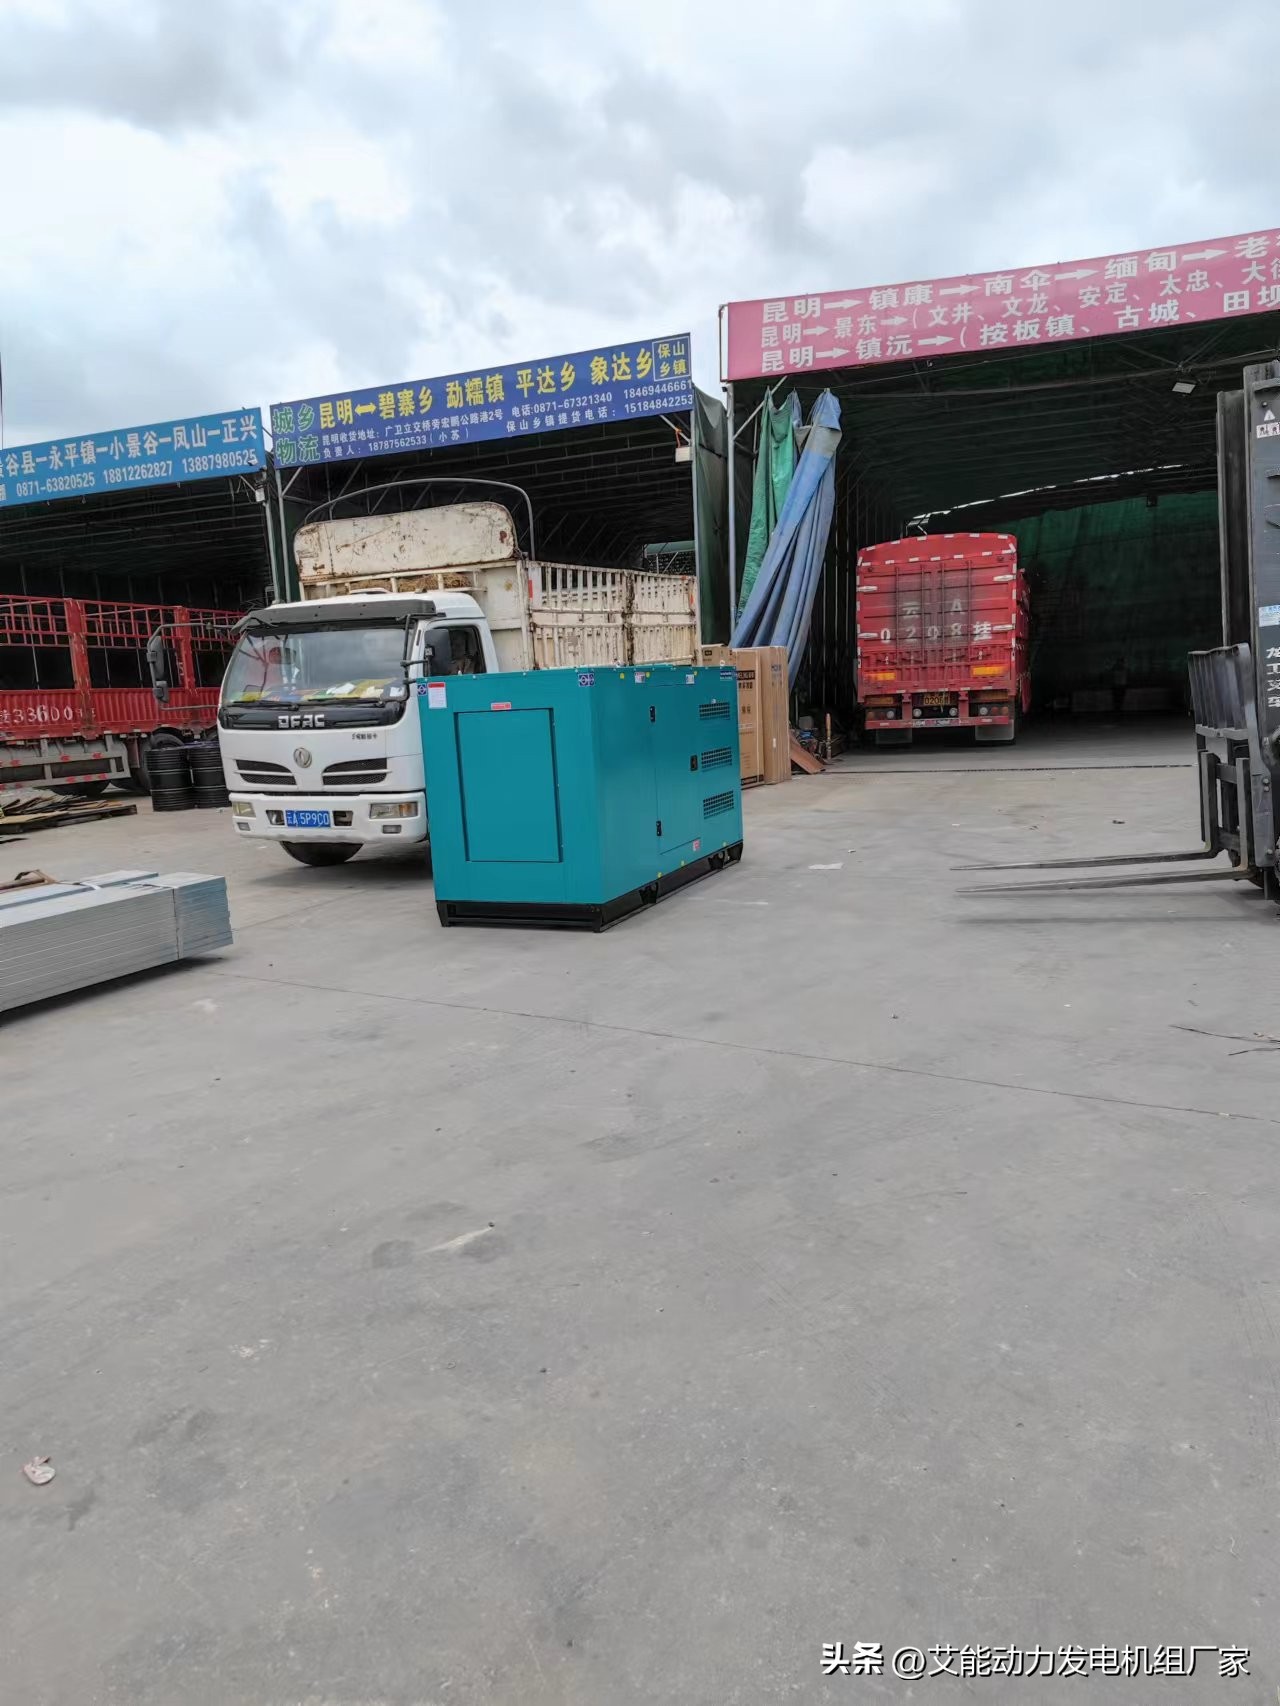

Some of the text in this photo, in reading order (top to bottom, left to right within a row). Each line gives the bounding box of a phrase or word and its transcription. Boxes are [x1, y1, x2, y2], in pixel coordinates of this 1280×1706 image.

[762, 235, 1280, 323] 昆明 镇康 南伞 缅甸 老
[761, 323, 801, 348] 昆明
[834, 315, 877, 339] 景东
[1001, 293, 1061, 319] 文龙、
[1079, 282, 1140, 309] 安定、
[1159, 269, 1223, 297] 太忠、
[658, 341, 685, 359] 保山
[761, 346, 813, 373] 昆明
[856, 335, 913, 360] 镇沅
[1113, 299, 1197, 329] 古城、
[659, 360, 686, 377] 乡镇
[320, 348, 653, 429] 昆明 碧寨乡 勐糯镇 平达乡 象达乡
[623, 380, 692, 400] 18469446661
[624, 394, 693, 414] 15184842253
[273, 403, 316, 434] 城乡
[276, 434, 320, 465] 物流
[16, 472, 95, 497] 0871-63820525
[103, 461, 173, 484] 18812262827
